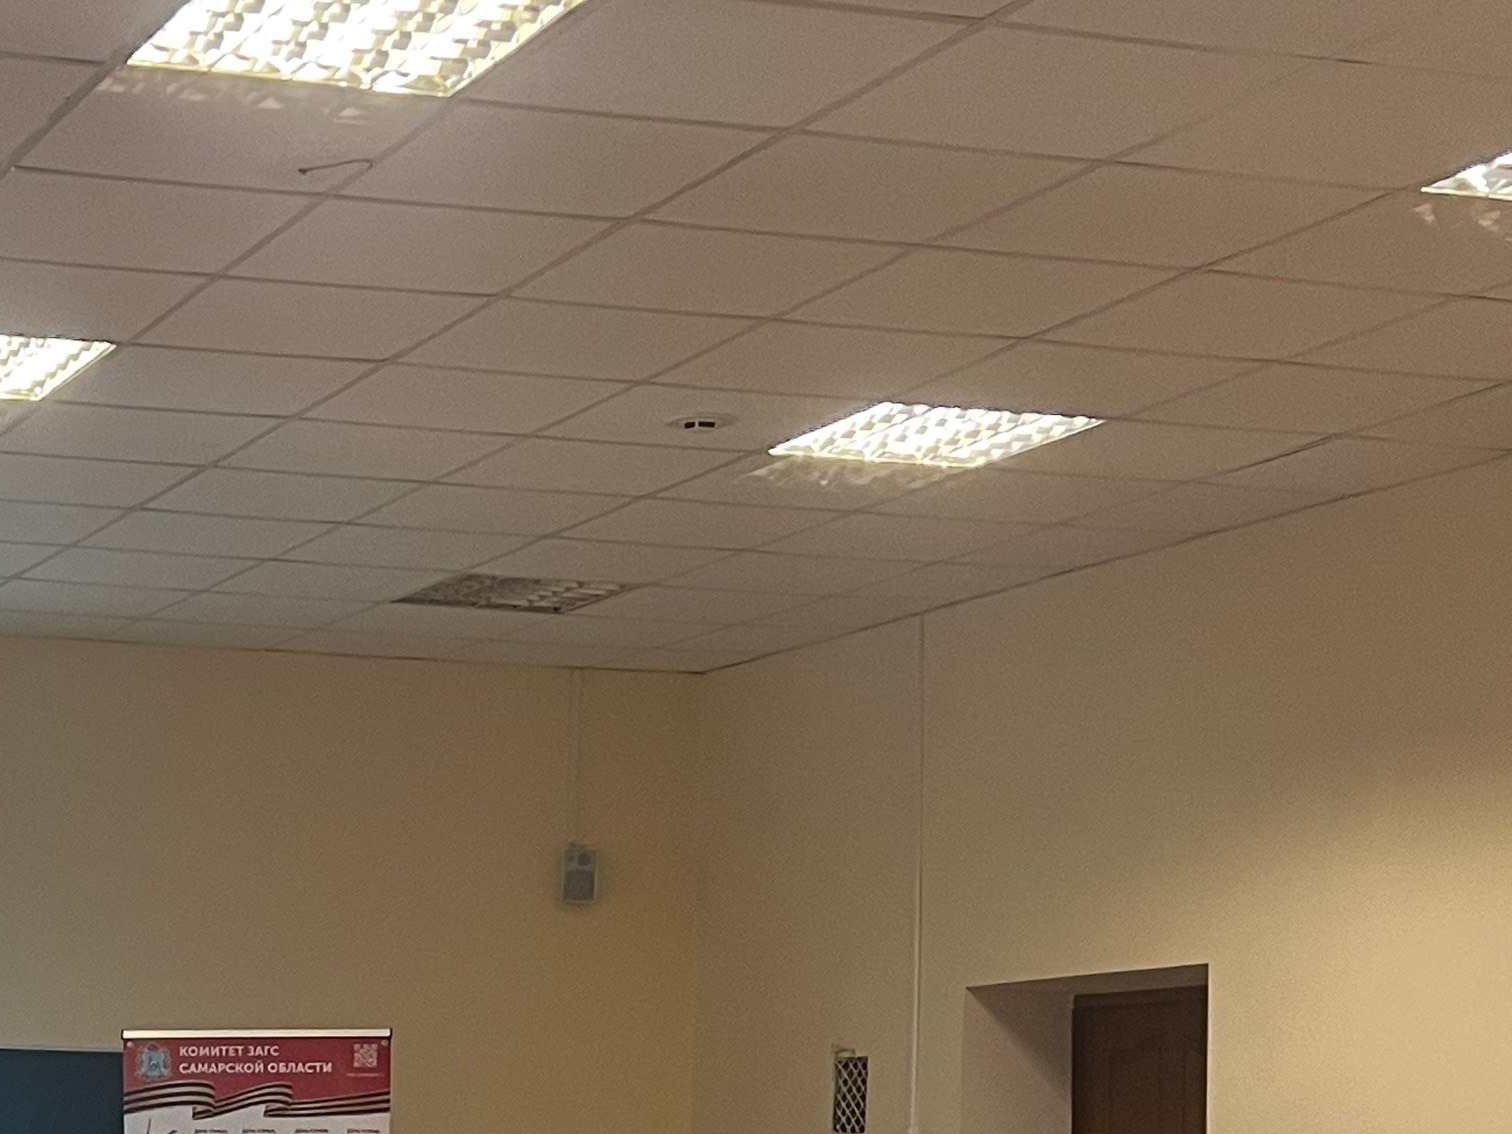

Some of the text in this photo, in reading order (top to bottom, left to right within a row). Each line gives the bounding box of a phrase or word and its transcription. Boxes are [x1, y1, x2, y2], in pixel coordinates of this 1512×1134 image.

[178, 1045, 280, 1057] КОМИТЕТ ЗАГС
[178, 1060, 333, 1074] САМАРСКОЙ ОБЛАСТИ
